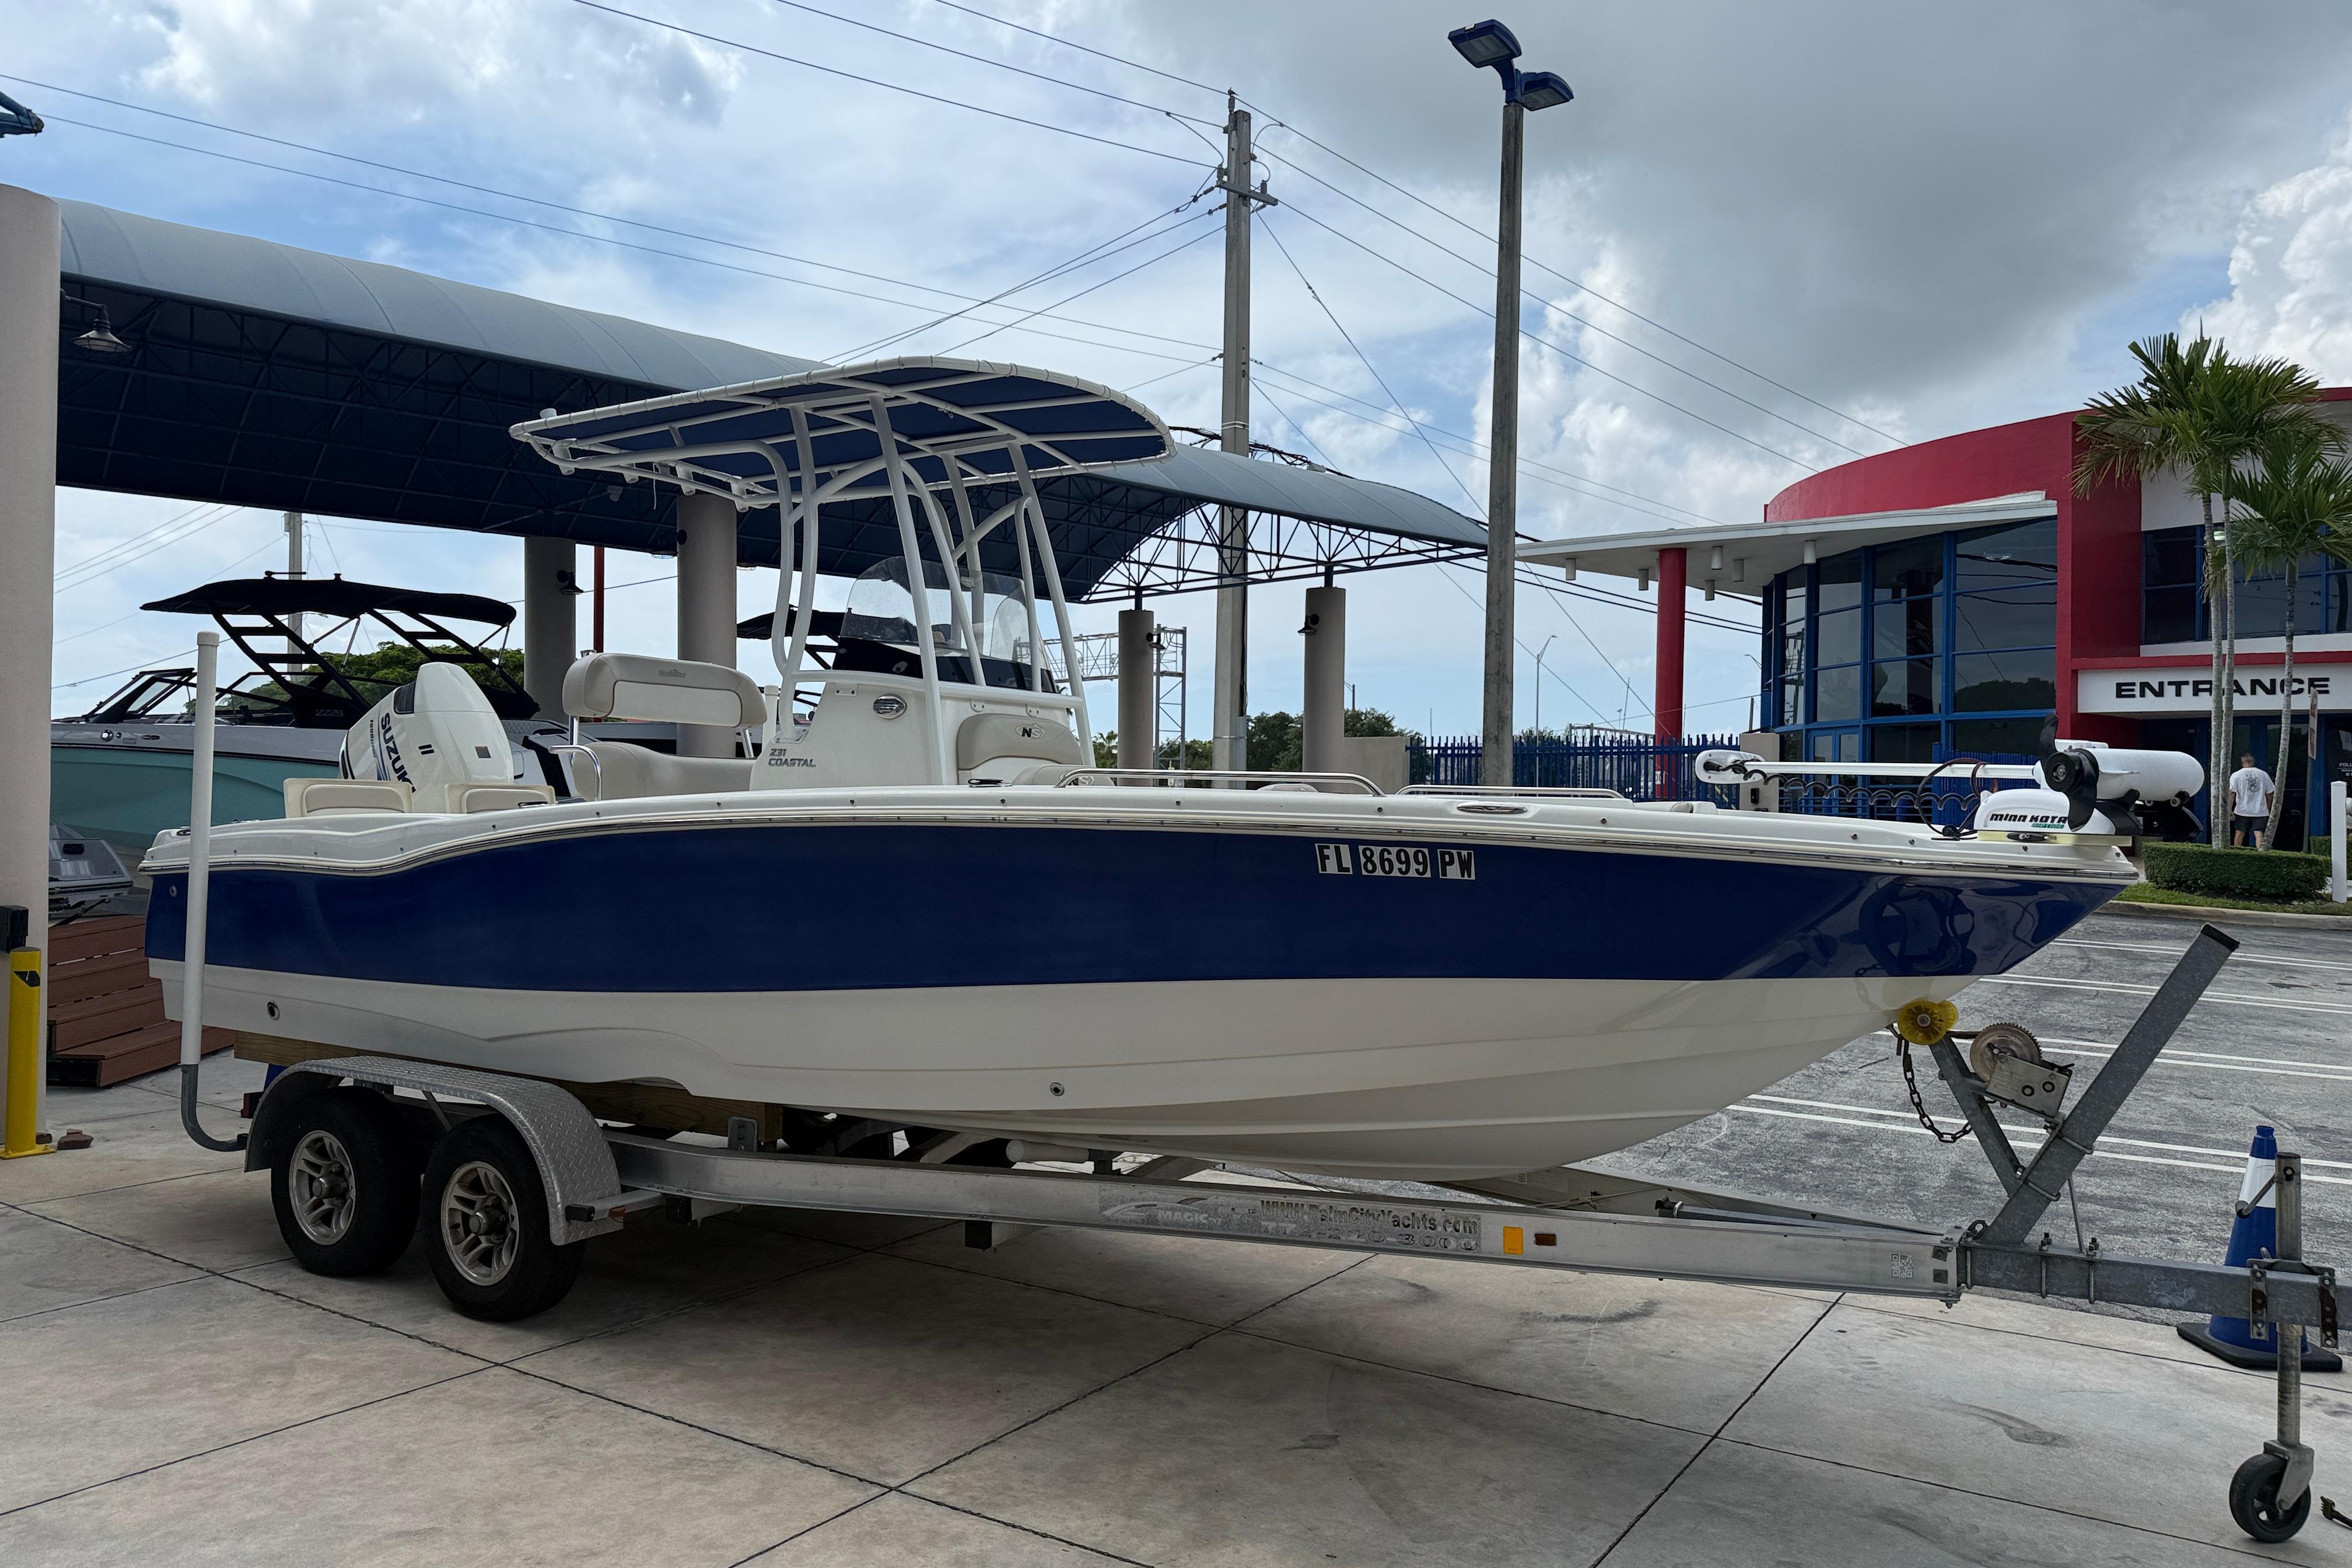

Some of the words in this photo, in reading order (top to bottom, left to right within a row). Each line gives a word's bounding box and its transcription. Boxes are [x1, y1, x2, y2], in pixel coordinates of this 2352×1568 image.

[2116, 677, 2330, 698] ENTRANCE
[769, 748, 787, 757] 231
[768, 758, 816, 768] COASTAL
[2029, 815, 2068, 824] KOTA
[1317, 845, 1350, 873] FL
[1361, 847, 1428, 876] 8699
[1439, 850, 1472, 878] PW
